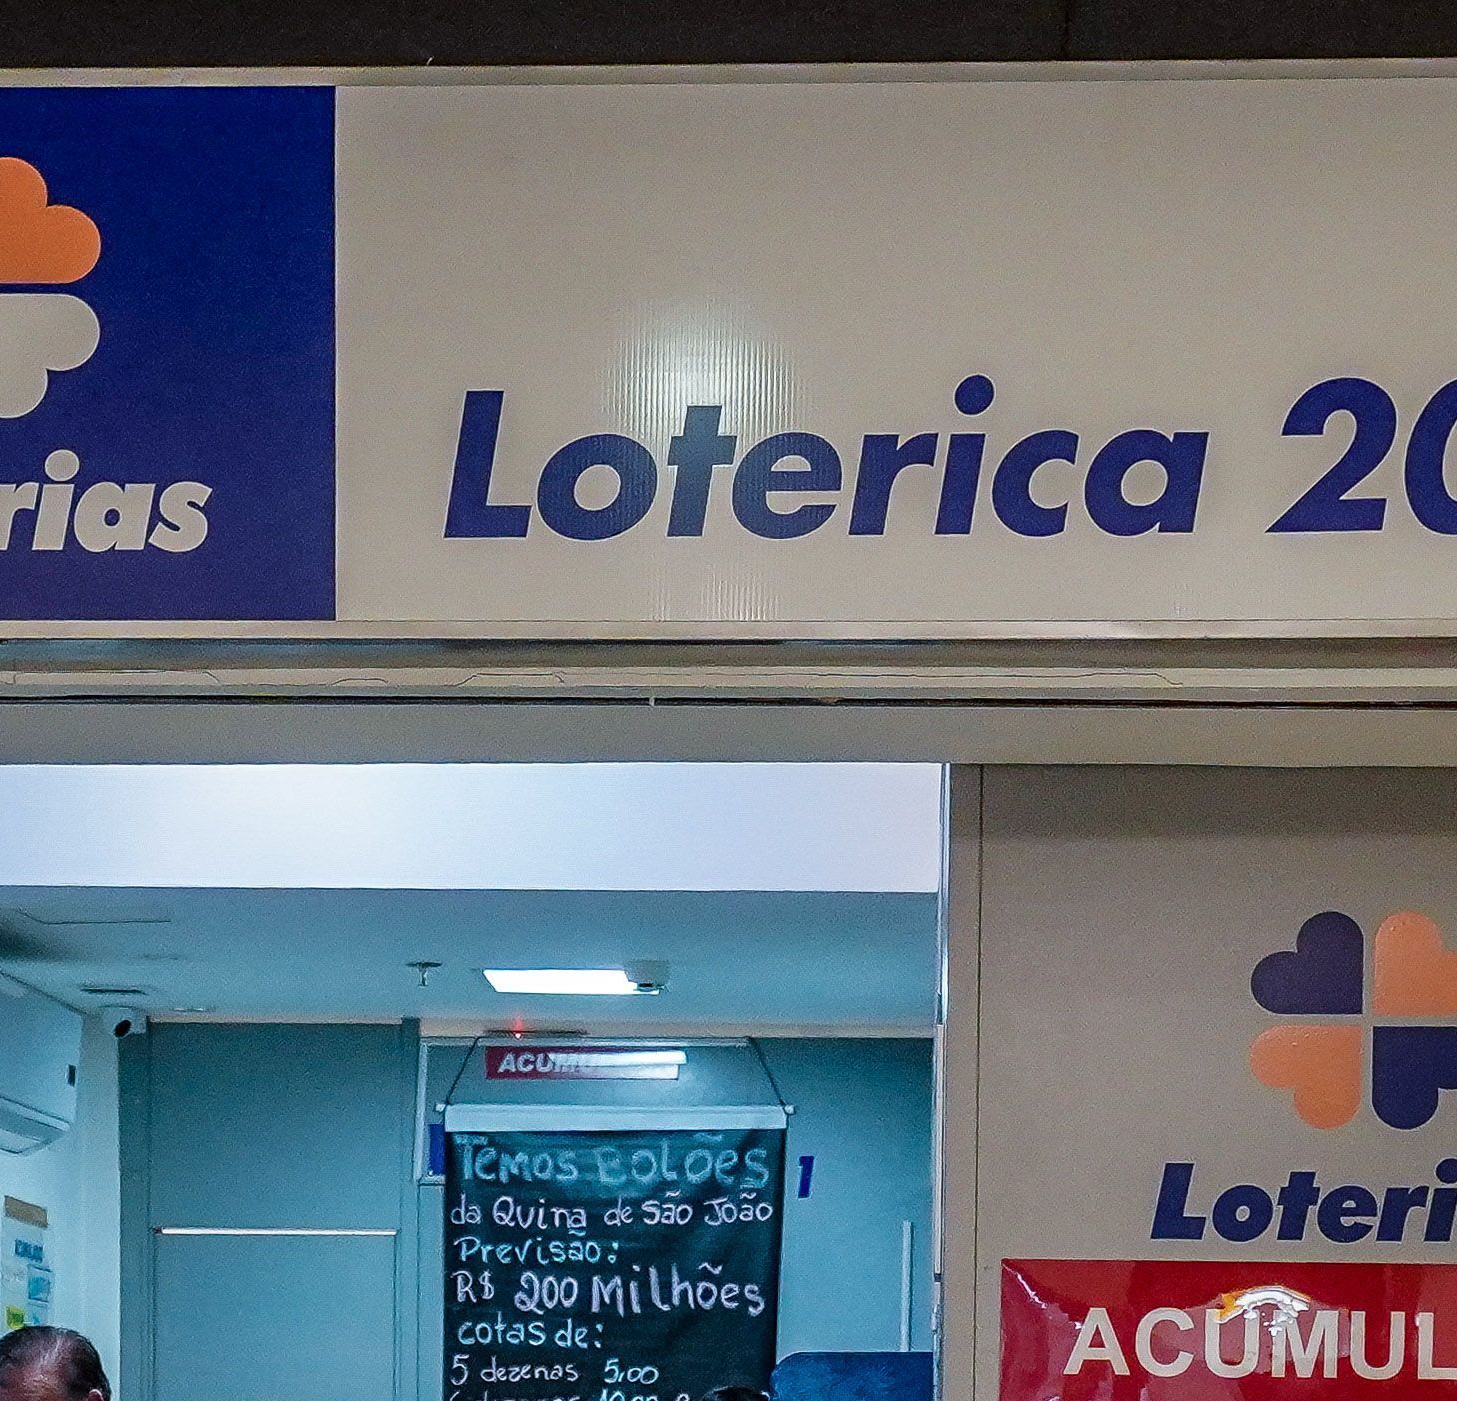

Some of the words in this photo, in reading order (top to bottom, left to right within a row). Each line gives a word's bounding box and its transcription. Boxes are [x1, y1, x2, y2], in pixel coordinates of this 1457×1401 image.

[442, 374, 1210, 540] Loterica
[450, 1191, 482, 1225] da
[492, 1195, 587, 1230] Quina
[603, 1195, 634, 1227] de
[641, 1189, 694, 1225] São
[703, 1191, 773, 1226] João
[452, 1229, 618, 1265] Previsão:
[450, 1269, 495, 1303] R$
[513, 1273, 579, 1314] 200
[590, 1261, 766, 1319] Milhões
[457, 1311, 546, 1346] cotas
[554, 1317, 604, 1350] de:
[449, 1353, 469, 1386] 5
[479, 1357, 579, 1384] dezenas
[603, 1358, 660, 1385] 5,00
